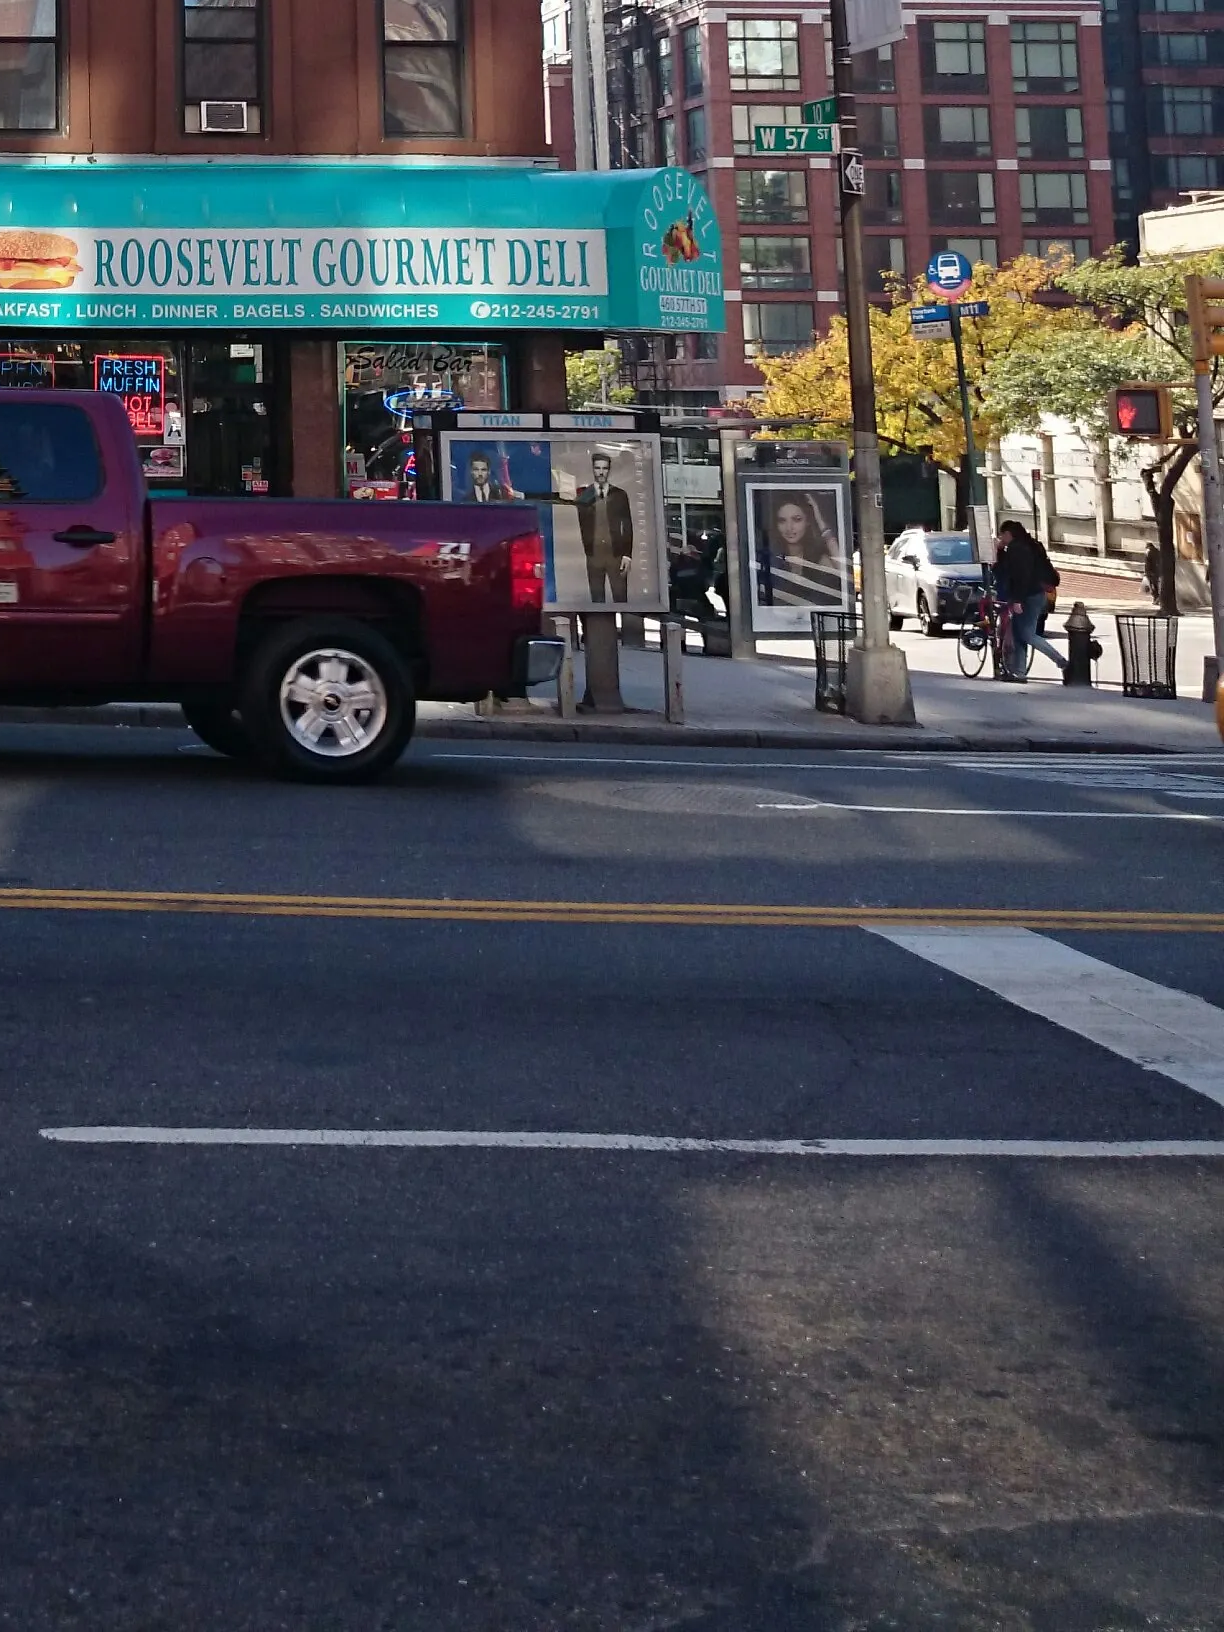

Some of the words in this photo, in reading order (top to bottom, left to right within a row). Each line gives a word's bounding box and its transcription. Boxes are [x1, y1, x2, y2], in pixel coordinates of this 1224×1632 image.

[812, 103, 823, 124] 10
[760, 128, 776, 149] W
[785, 128, 809, 150] 57
[817, 128, 830, 139] ST
[94, 238, 302, 287] ROOSEVELT
[313, 238, 495, 287] GOURMET
[506, 239, 591, 287] DELI
[640, 266, 695, 294] GOURMET
[697, 270, 721, 296] DELI
[76, 303, 137, 318] LUNCH
[152, 304, 218, 319] DINNER
[233, 303, 305, 319] BAGELS
[319, 303, 439, 318] SANDWICHES
[491, 304, 600, 320] 212-245-2791
[102, 360, 156, 376] FRESH
[350, 346, 423, 370] Salad
[432, 349, 474, 372] Bar
[100, 377, 160, 393] MUFFIN
[480, 415, 520, 426] TITAN
[571, 416, 612, 427] TITAN
